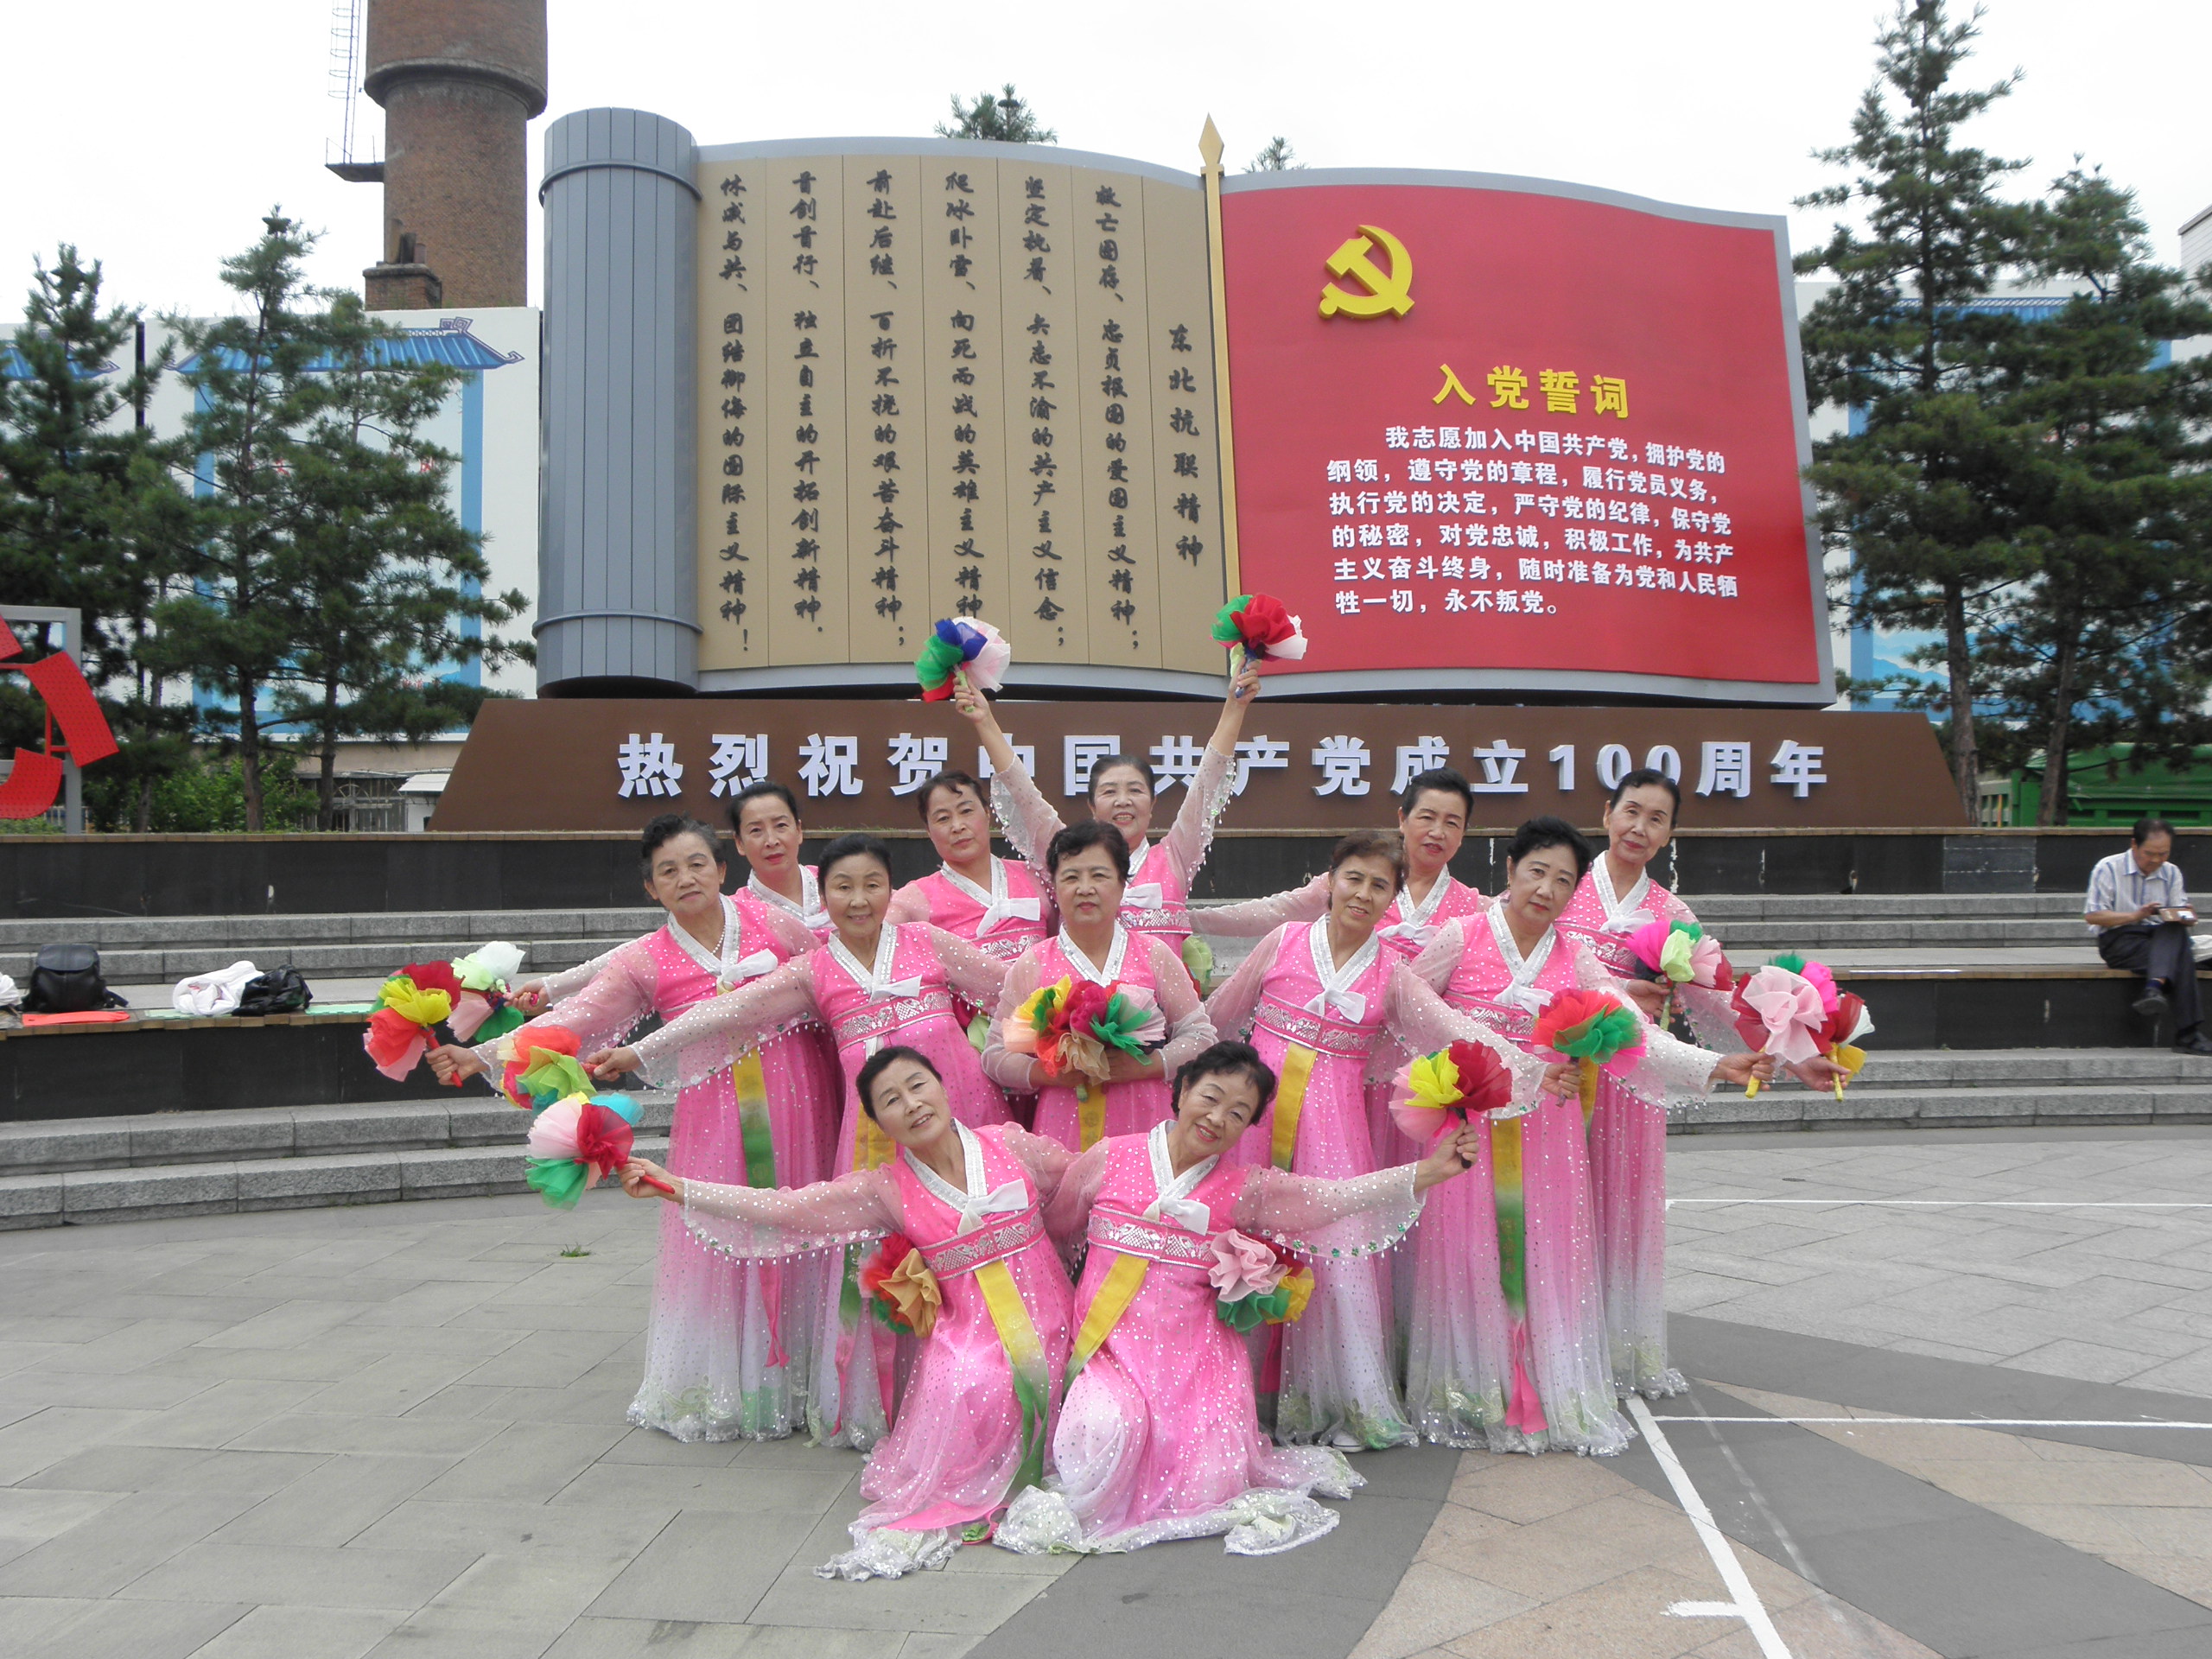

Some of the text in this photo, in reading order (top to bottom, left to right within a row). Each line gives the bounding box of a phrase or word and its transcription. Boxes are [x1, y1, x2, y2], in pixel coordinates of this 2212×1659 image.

[1433, 364, 1629, 419] 入党誓词
[1169, 323, 1204, 566] 东北抗联精神
[1385, 426, 1726, 474] 我志愿加入中国共产党，拥护党的
[1335, 589, 1558, 614] 牲一切，永不叛党。
